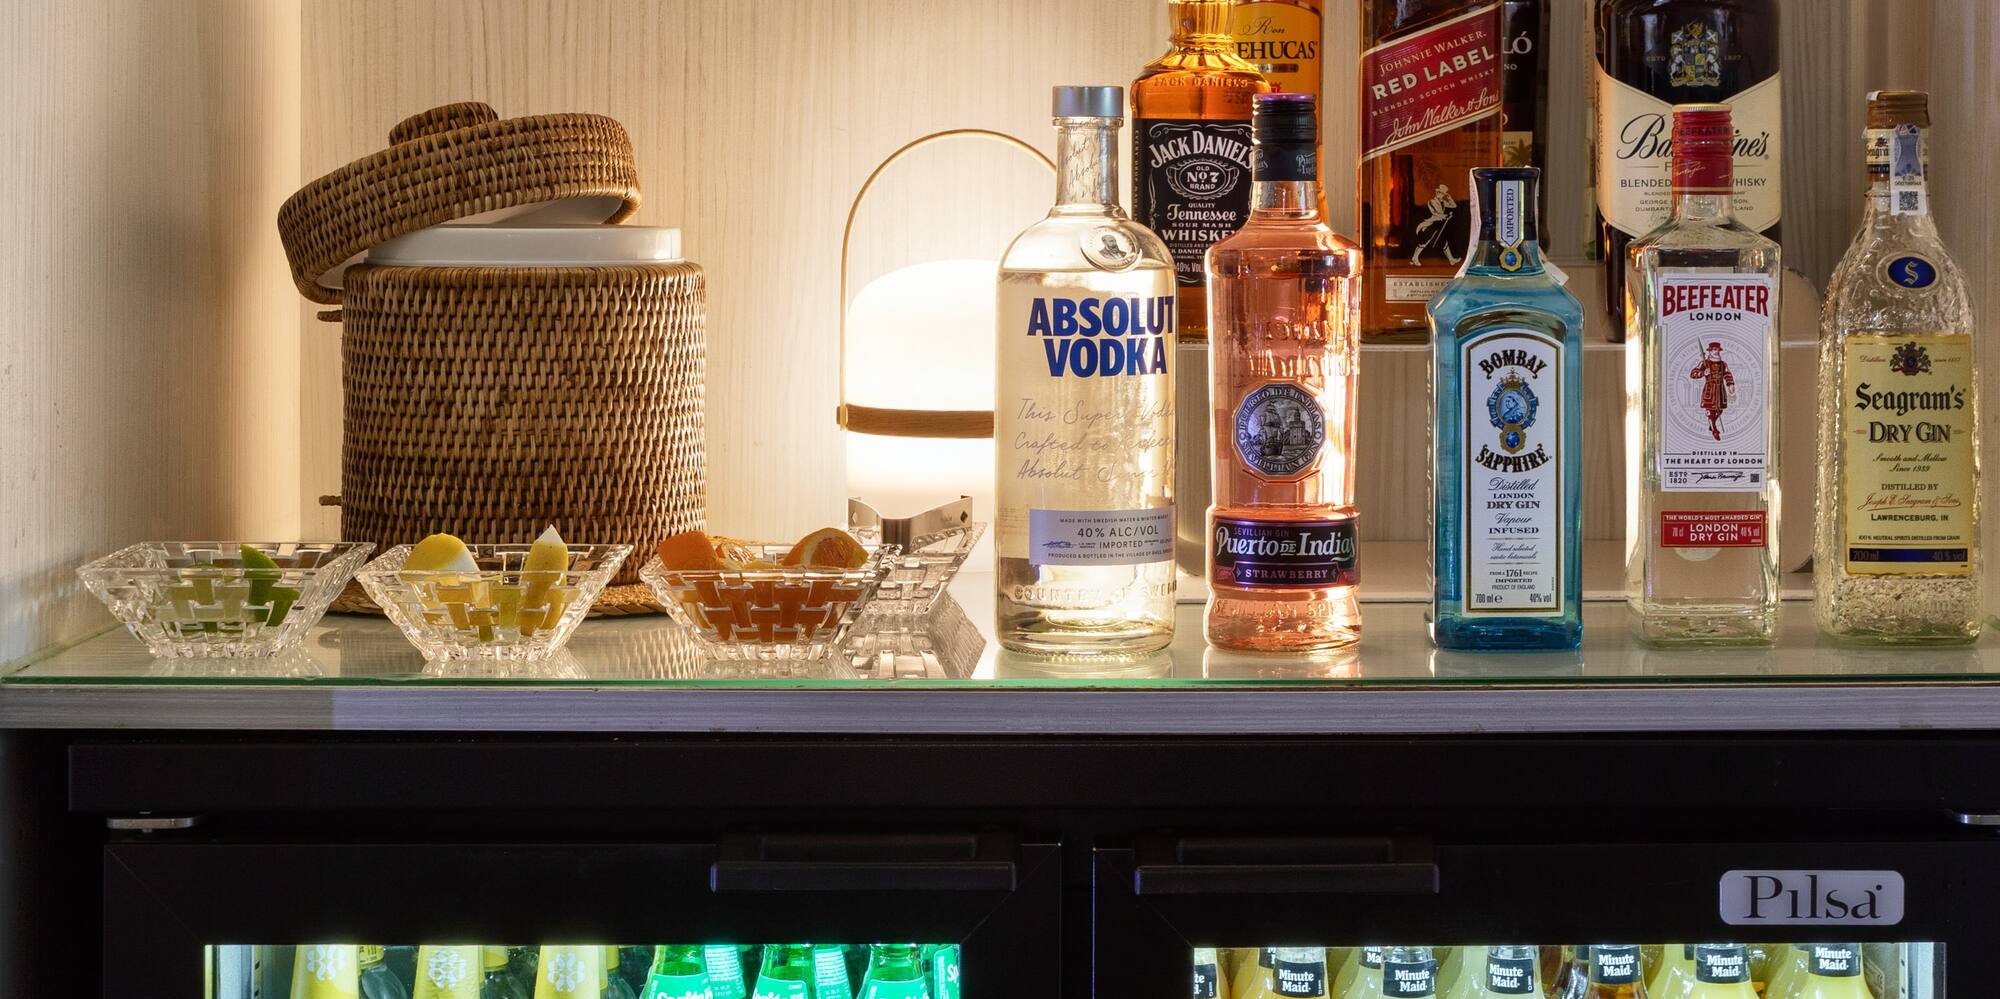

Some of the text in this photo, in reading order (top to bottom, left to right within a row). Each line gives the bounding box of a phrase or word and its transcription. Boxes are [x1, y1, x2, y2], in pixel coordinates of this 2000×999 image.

[1242, 16, 1285, 36] Ron
[1233, 41, 1317, 60] EHUCAS
[1380, 49, 1433, 77] JOHNNIE
[1372, 46, 1495, 100] RED LABEL
[1154, 76, 1186, 87] JACK
[1372, 68, 1495, 116] BLENDED SCOTCH WHISKY
[1385, 116, 1420, 145] John
[1420, 101, 1466, 128] Walker
[1149, 136, 1191, 168] JACK
[1210, 171, 1220, 183] 7
[1620, 178, 1672, 188] BLENDED
[1732, 178, 1767, 187] HISKY
[1166, 203, 1237, 221] Tennessee
[1506, 188, 1514, 238] IMPORTED
[1663, 285, 1769, 317] BEEFEATER
[1027, 296, 1175, 337] ABSOLUT
[1689, 312, 1741, 320] LONDON
[1043, 337, 1167, 378] VODKA
[1478, 349, 1548, 380] BOMBAY
[1855, 382, 1966, 416] Seagram's
[1017, 398, 1056, 421] This
[1239, 387, 1322, 430] PUERTO DE INDIAS
[1868, 421, 1952, 443] DRY GIN
[1015, 431, 1083, 454] Crafted
[1088, 439, 1110, 451] to
[1475, 443, 1549, 473] SAPPHIRE
[1872, 453, 1947, 462] Smooth and Mellow
[1017, 458, 1090, 480] Absolut
[1889, 463, 1910, 473] Since
[1488, 476, 1540, 491] Distilled
[1881, 483, 1939, 491] DISTILLED BY
[1486, 500, 1541, 509] DRY GIN
[1495, 512, 1532, 526] Vapour
[1077, 525, 1159, 538] 40% ALC/VOL
[1234, 527, 1289, 537] SEVILLIAN GIN
[1488, 527, 1539, 535] INFUSED
[1689, 523, 1738, 532] LONDON
[1215, 526, 1356, 557] Puerto DE Indias
[1690, 533, 1738, 541] DRY GIN
[1099, 540, 1143, 549] IMPORTED
[1245, 569, 1329, 579] STRAWBERRY
[1506, 569, 1522, 577] 1761
[1598, 954, 1635, 966] Minute
[1706, 954, 1743, 966] Minute
[1815, 947, 1852, 959] Minute
[1279, 969, 1315, 982] Minute
[1394, 969, 1430, 981] Minute
[1489, 963, 1524, 977] Minute
